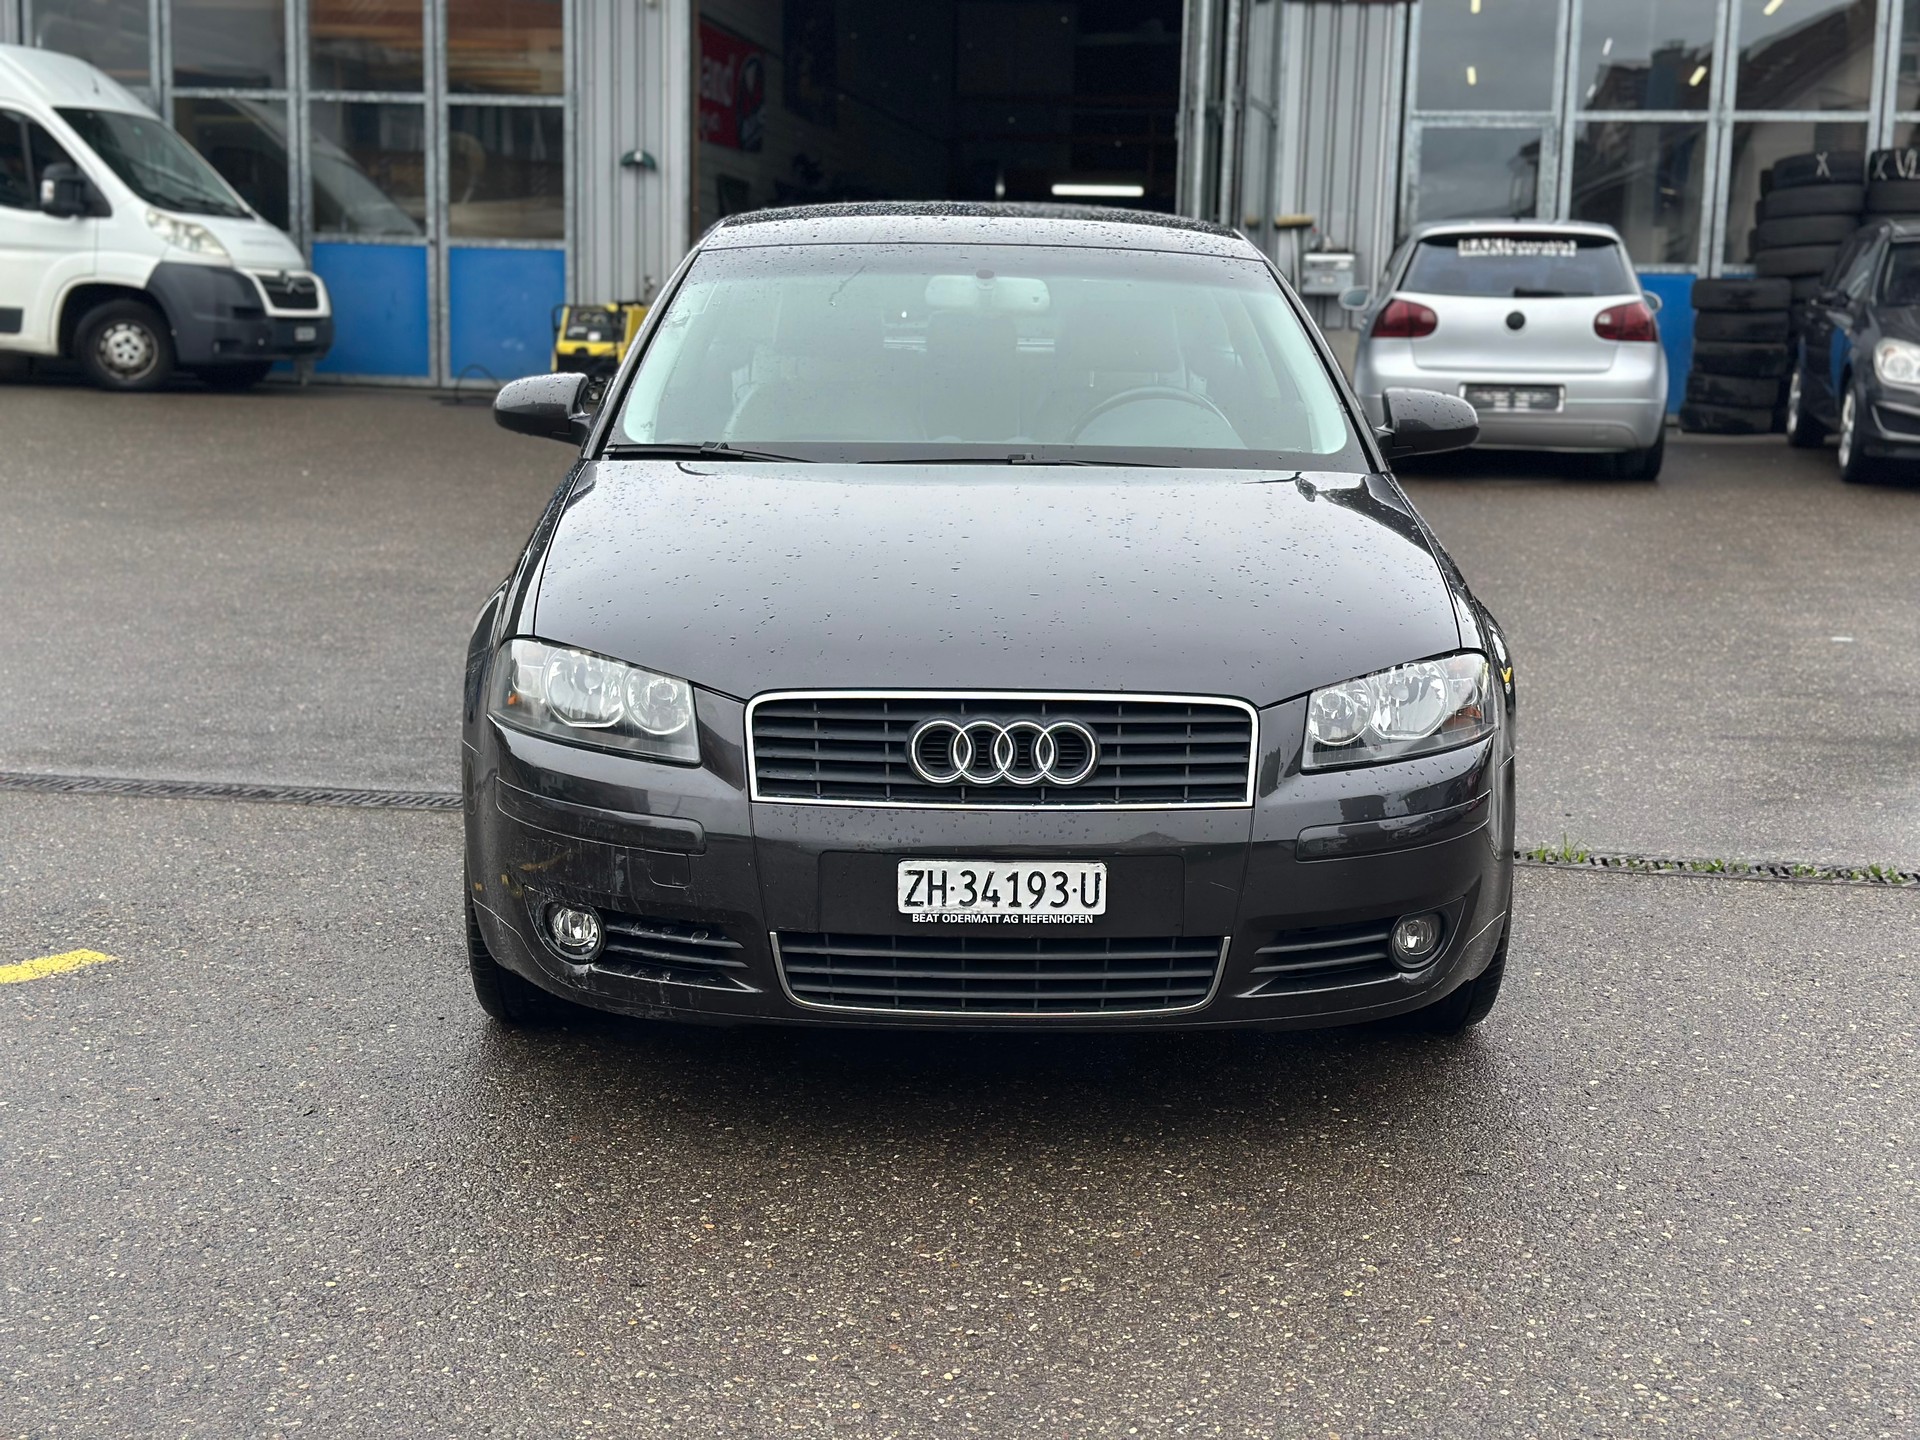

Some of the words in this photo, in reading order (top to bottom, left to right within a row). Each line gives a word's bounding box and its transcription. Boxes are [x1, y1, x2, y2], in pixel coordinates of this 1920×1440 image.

[911, 913, 940, 924] BEAT
[941, 913, 1001, 924] ODERMATT
[1002, 914, 1019, 924] AG
[1022, 914, 1094, 925] HEFENHOFEN
